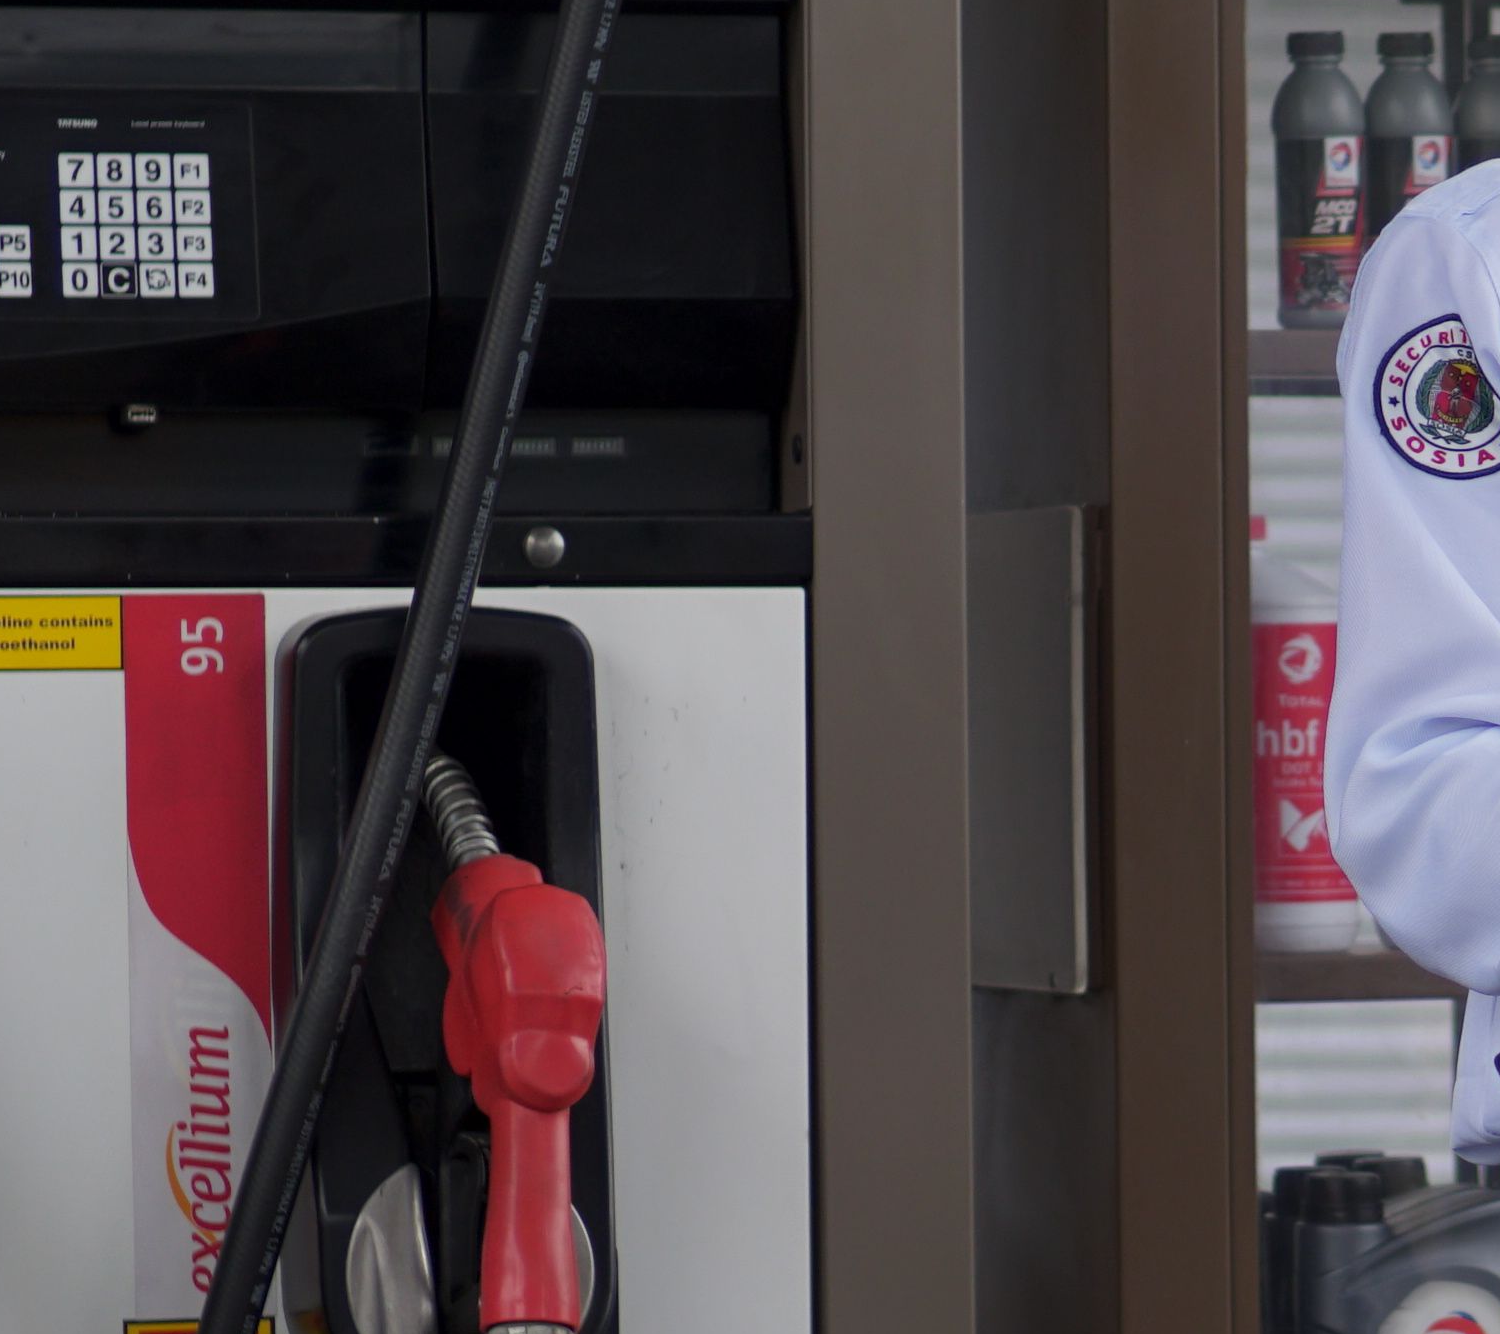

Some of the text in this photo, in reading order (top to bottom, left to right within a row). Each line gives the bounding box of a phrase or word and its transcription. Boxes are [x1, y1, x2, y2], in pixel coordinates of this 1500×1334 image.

[68, 159, 200, 182] 7 8 9 F1
[69, 195, 204, 219] 4 5 6 F2
[538, 181, 570, 267] FUTURA
[1310, 217, 1355, 235] 2T
[0, 234, 26, 252] P5
[71, 232, 205, 255] 1 2 3 F3
[71, 267, 207, 293] 0 C F4
[1389, 329, 1467, 387] SECURIT
[1390, 416, 1496, 467] SOSIA
[39, 616, 113, 629] contains
[180, 616, 225, 676] 95
[1256, 719, 1320, 757] hbf
[378, 797, 411, 881] FUTURA
[177, 1025, 232, 1293] excellium
